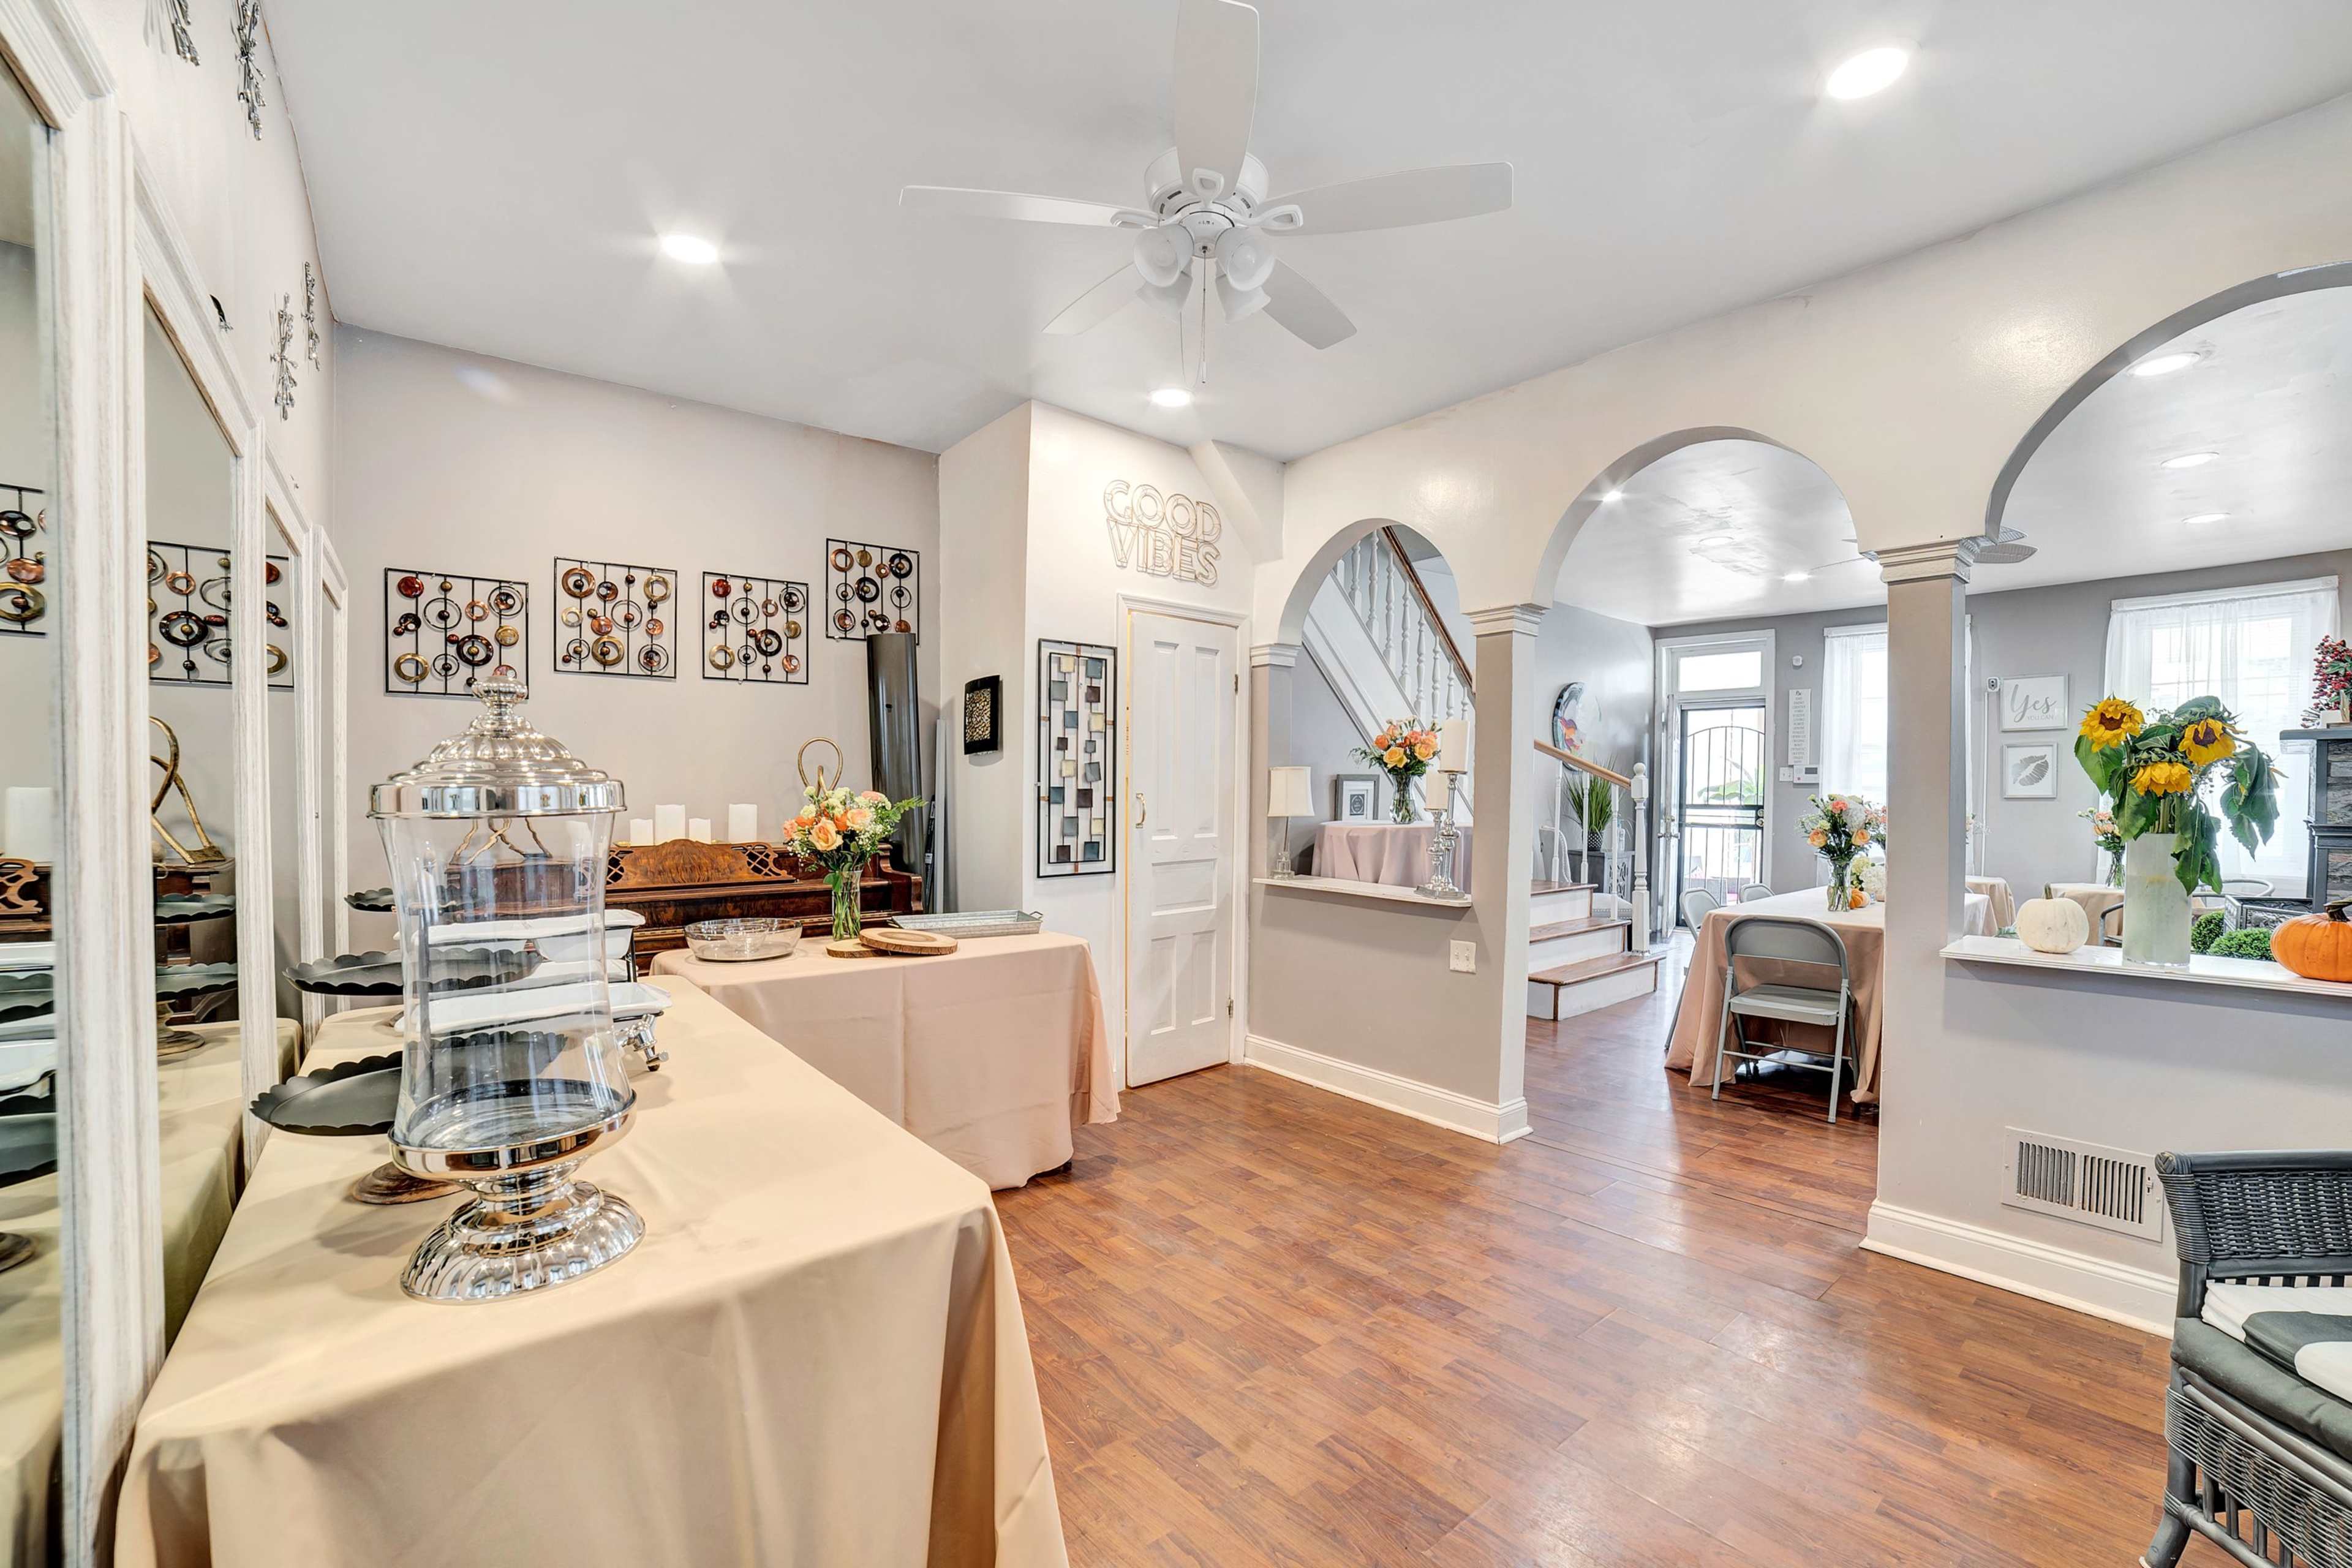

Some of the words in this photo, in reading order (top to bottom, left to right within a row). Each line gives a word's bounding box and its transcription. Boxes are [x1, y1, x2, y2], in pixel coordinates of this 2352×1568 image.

[1104, 479, 1221, 544] GOOD
[1106, 516, 1221, 586] VIBES
[2010, 684, 2057, 723] Yes
